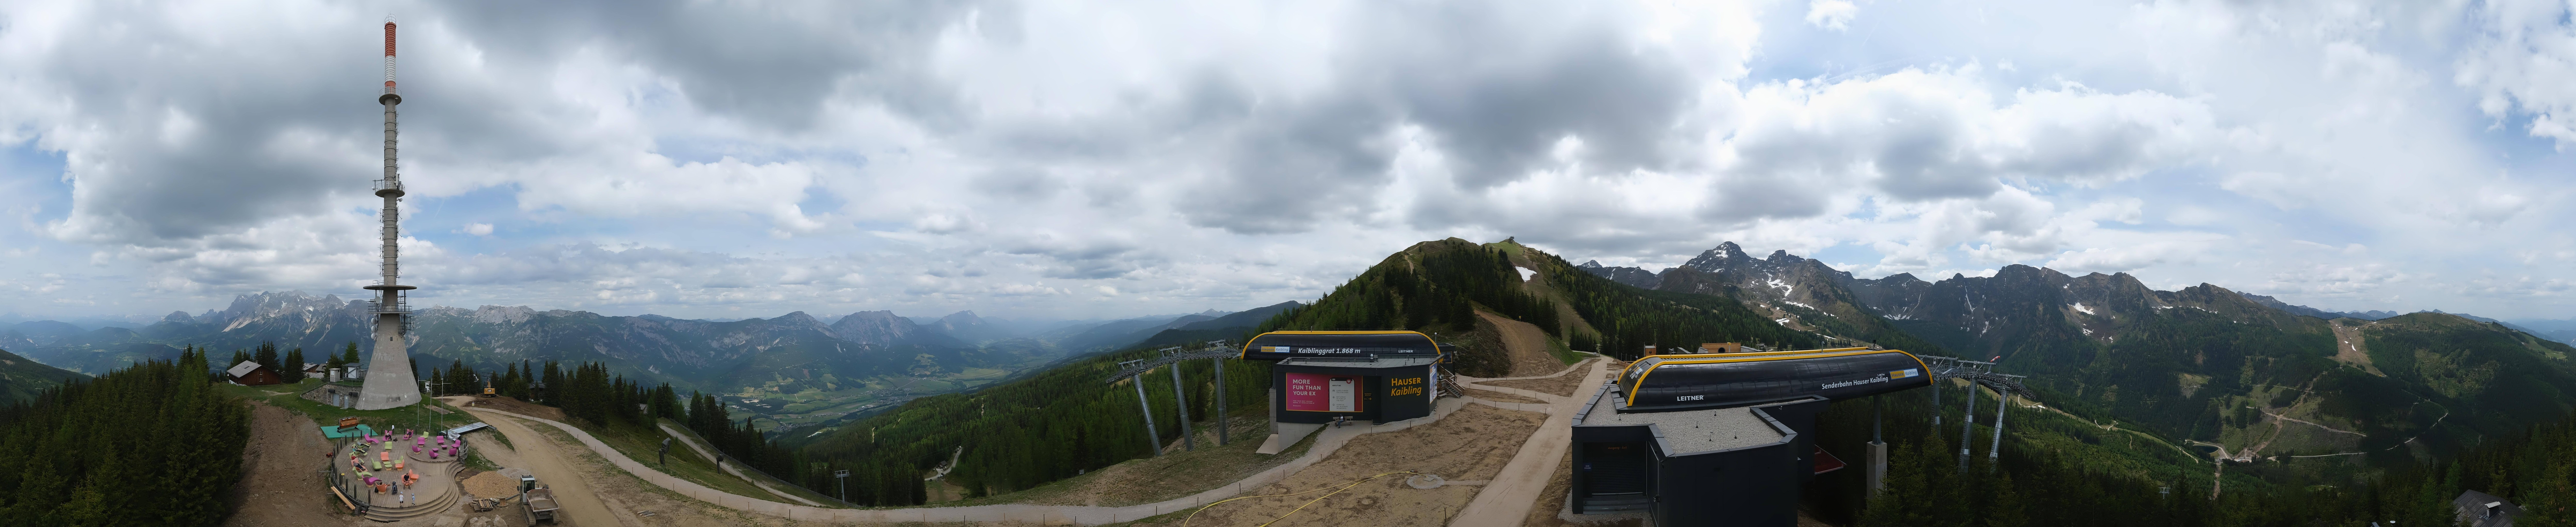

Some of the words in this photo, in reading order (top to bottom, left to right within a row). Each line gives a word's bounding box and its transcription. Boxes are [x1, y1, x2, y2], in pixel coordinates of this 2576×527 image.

[1392, 378, 1421, 386] HAUSER
[1822, 380, 1852, 389] Senderbahn
[1391, 386, 1422, 396] Kaibling
